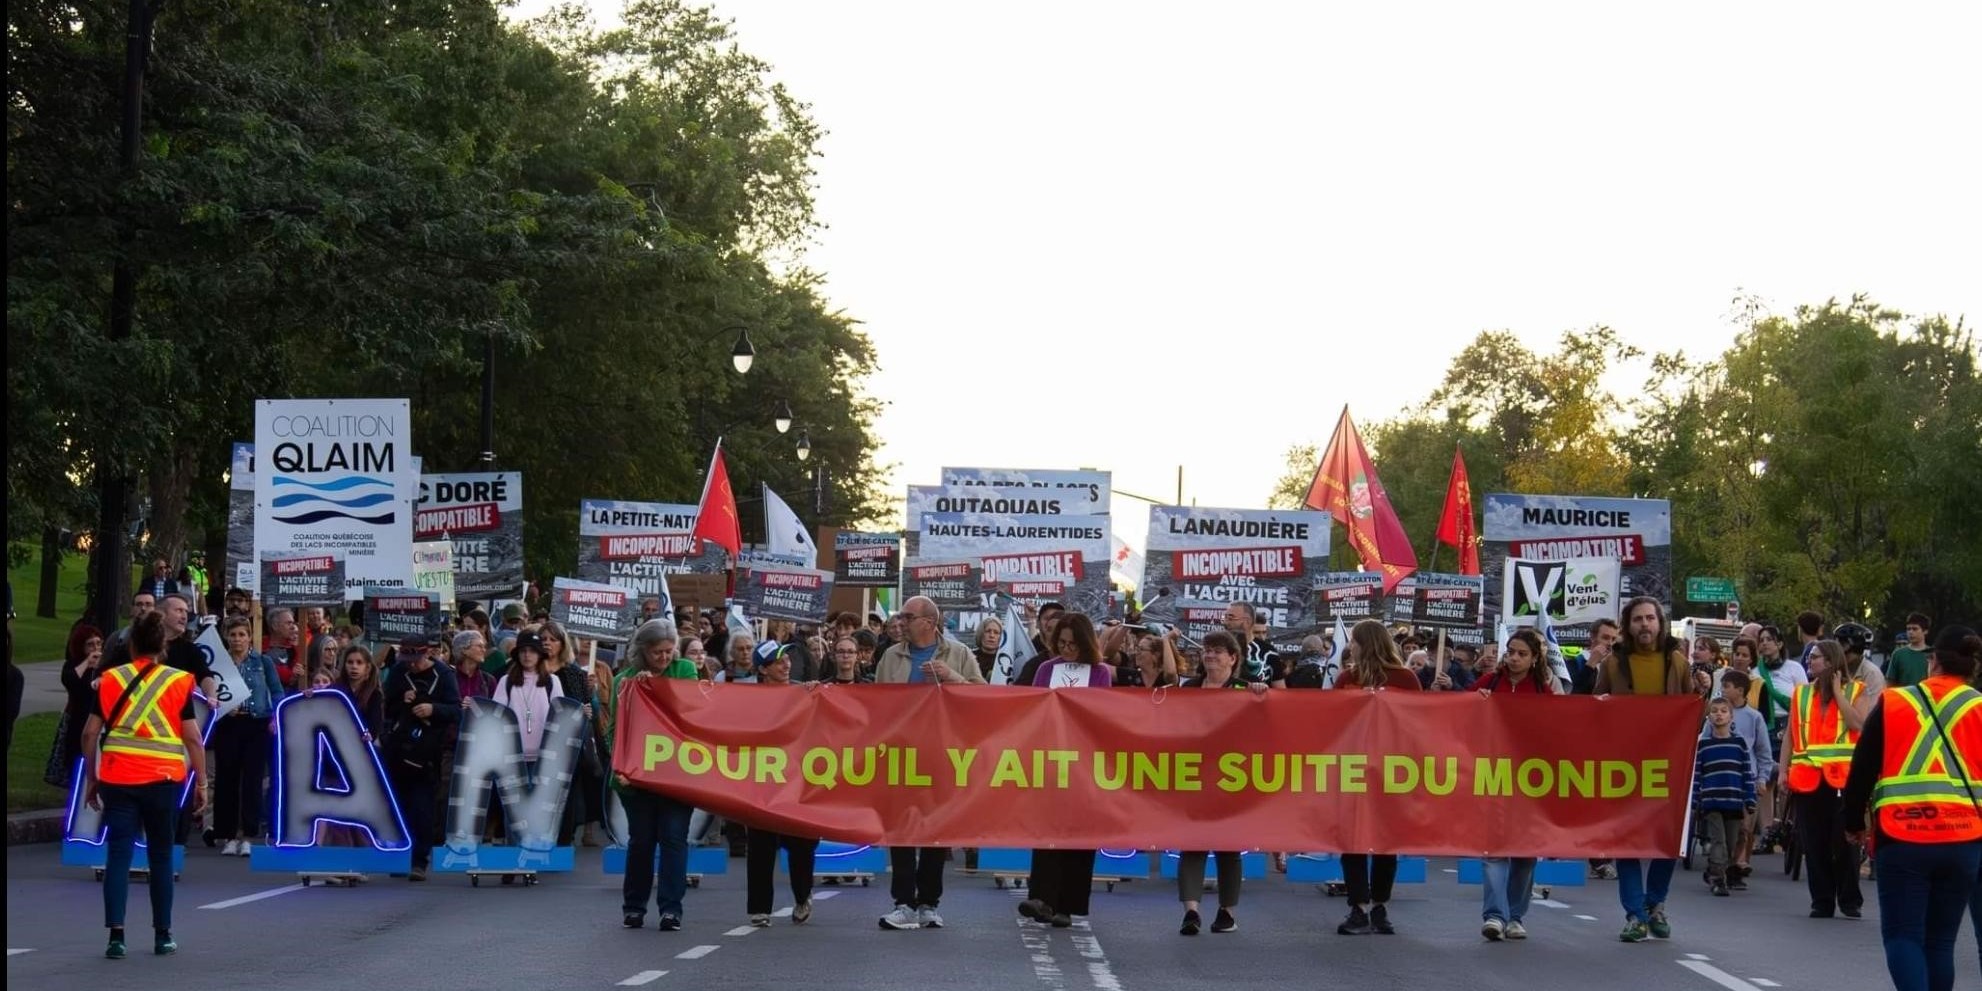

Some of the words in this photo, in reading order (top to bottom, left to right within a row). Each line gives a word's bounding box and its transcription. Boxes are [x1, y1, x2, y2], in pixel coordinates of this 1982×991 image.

[272, 415, 395, 438] COALITION
[272, 442, 395, 474] QLAIM
[436, 474, 507, 502] DORÉ
[936, 497, 1061, 515] OUTAOUAIS
[417, 505, 492, 531] OMPATIBLE
[592, 510, 609, 525] LA
[613, 511, 696, 529] PETITE-NATI
[1170, 516, 1309, 540] LANAUDIÈRE
[1522, 507, 1631, 528] MAURICIE
[929, 524, 1103, 539] HAUTES-LAURENTIDES
[640, 555, 665, 564] AVEC
[1520, 537, 1636, 562] INCOMPATIBLE
[1183, 550, 1295, 577] INCOMPATIBLE
[1219, 576, 1256, 586] AVEC
[1567, 584, 1598, 594] Vent
[1184, 583, 1289, 604] L'ACTIVITÉ
[1567, 596, 1606, 607] d'élus
[643, 734, 787, 784] POUR
[802, 743, 932, 791] QU'IL
[946, 749, 978, 788] Y
[990, 749, 1079, 790] AIT
[1093, 752, 1202, 792] UNE
[1216, 752, 1367, 793] SUITE
[1383, 756, 1458, 796] DU
[1473, 757, 1670, 798] MONDE
